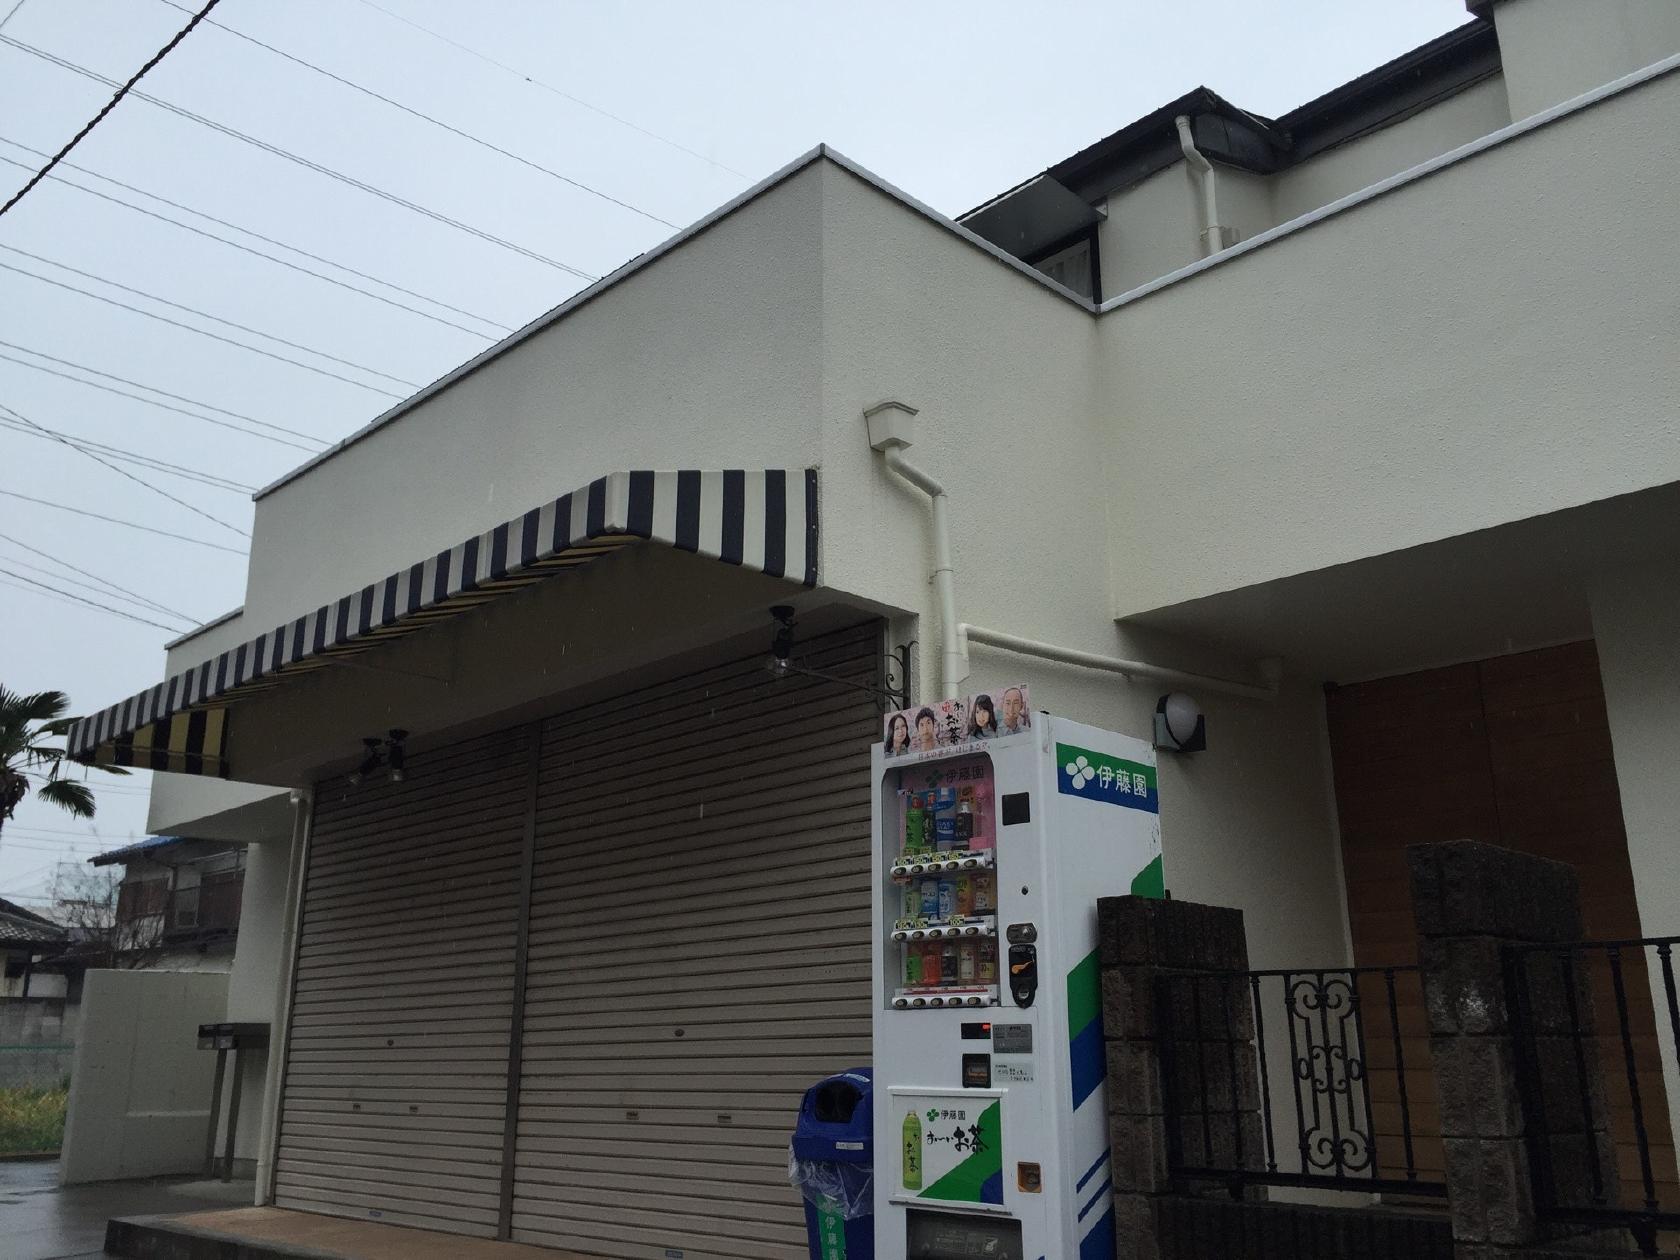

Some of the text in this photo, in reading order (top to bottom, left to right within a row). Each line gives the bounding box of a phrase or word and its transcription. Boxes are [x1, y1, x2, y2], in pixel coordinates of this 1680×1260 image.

[1096, 764, 1147, 798] 伊藤園
[941, 1109, 966, 1121] 伊藤園
